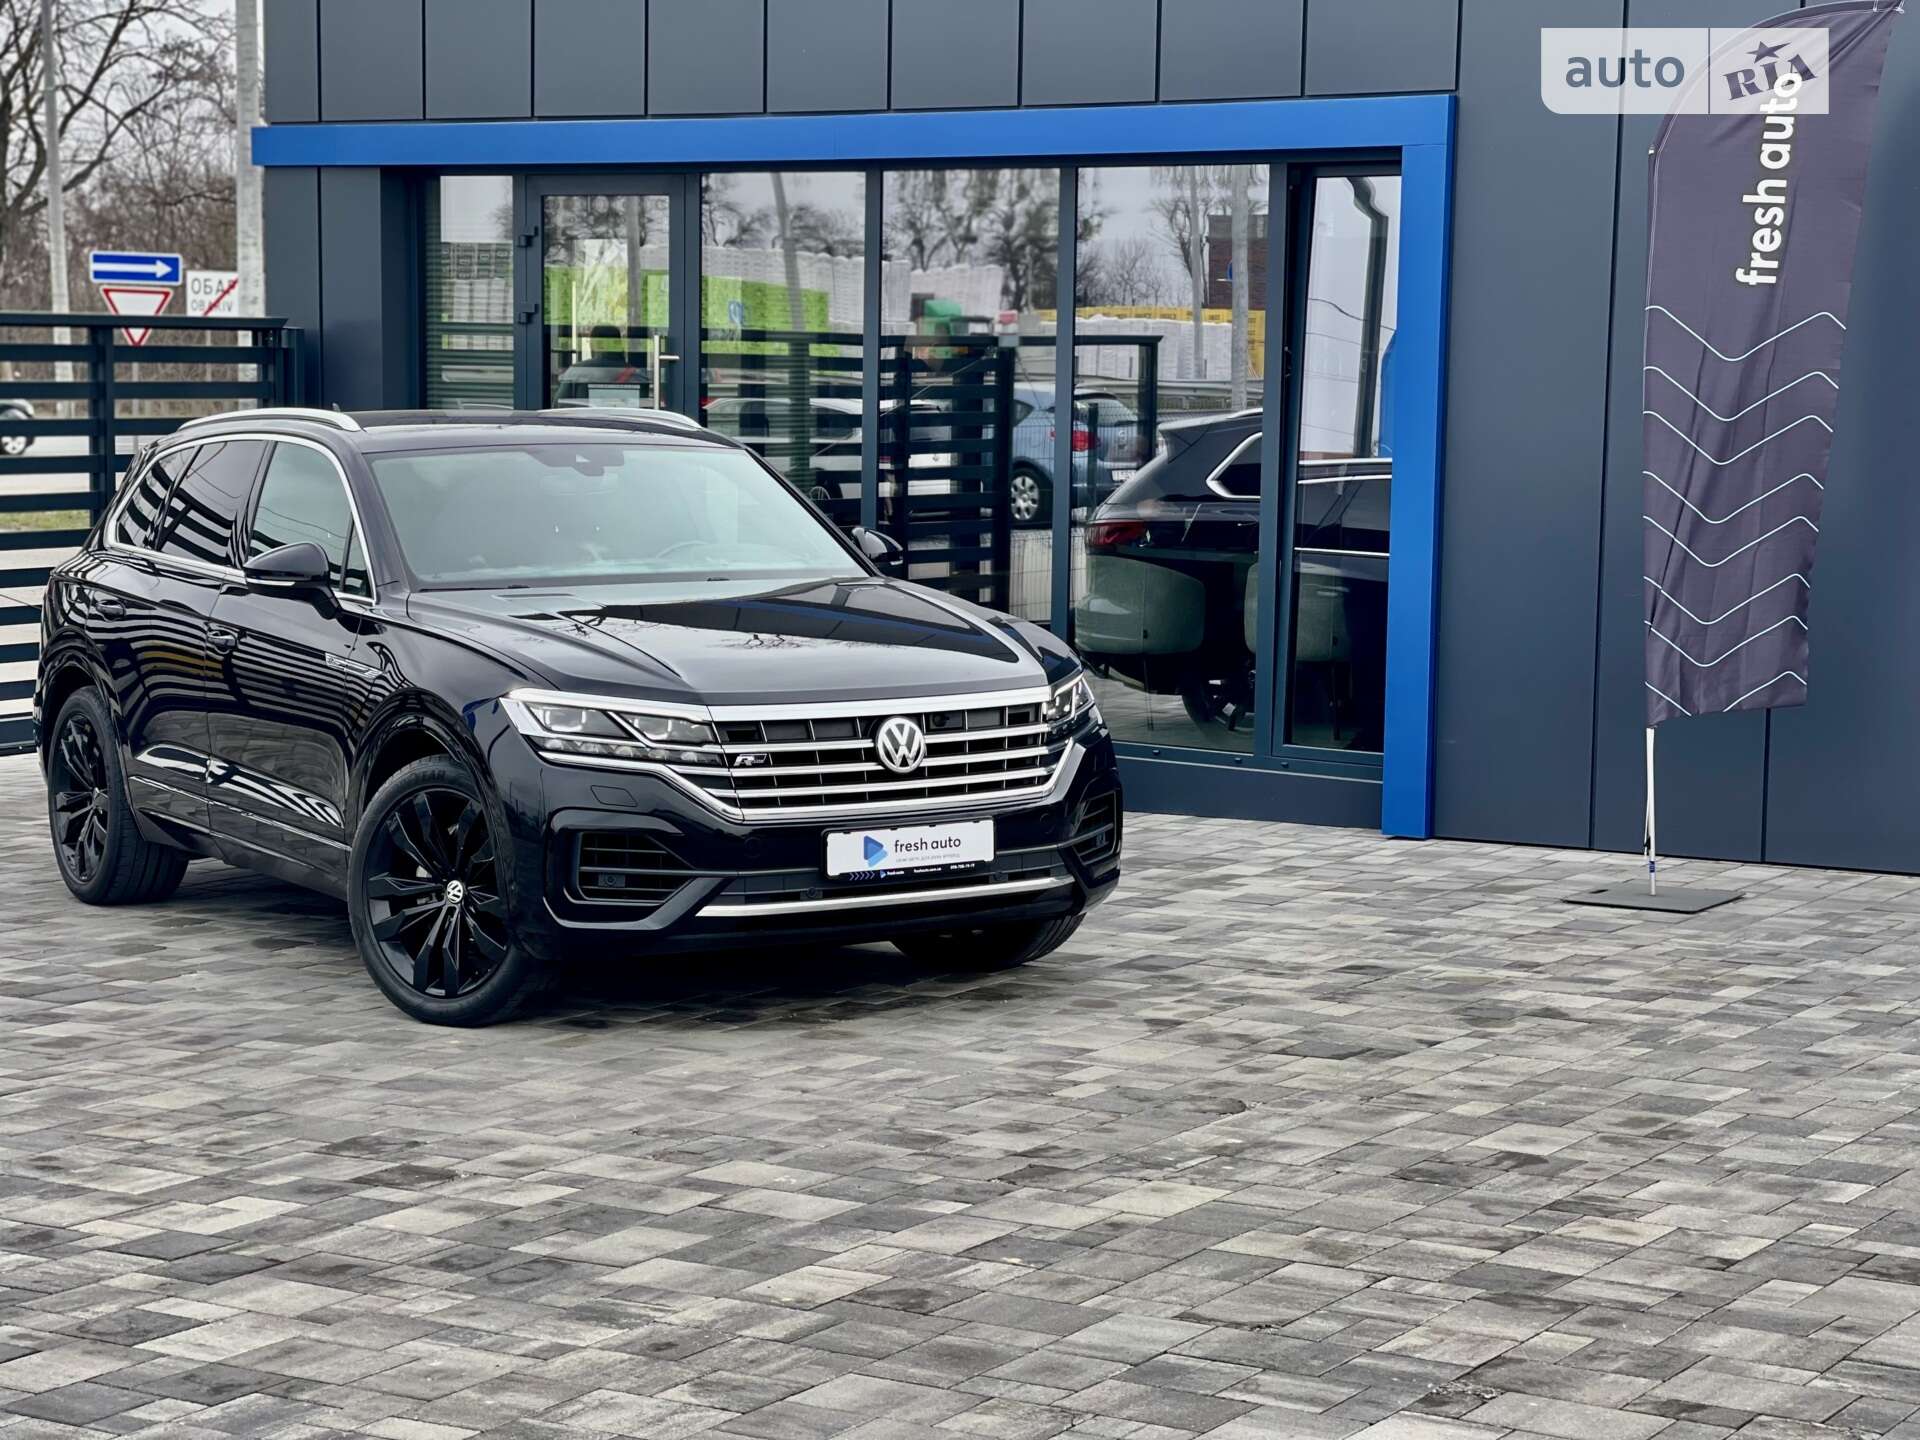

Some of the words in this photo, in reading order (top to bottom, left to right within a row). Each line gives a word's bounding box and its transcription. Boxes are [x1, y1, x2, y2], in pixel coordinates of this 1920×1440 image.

[1759, 72, 1803, 169] auto
[1735, 179, 1788, 286] fresh
[894, 838, 928, 853] fresh
[931, 836, 962, 850] auto
